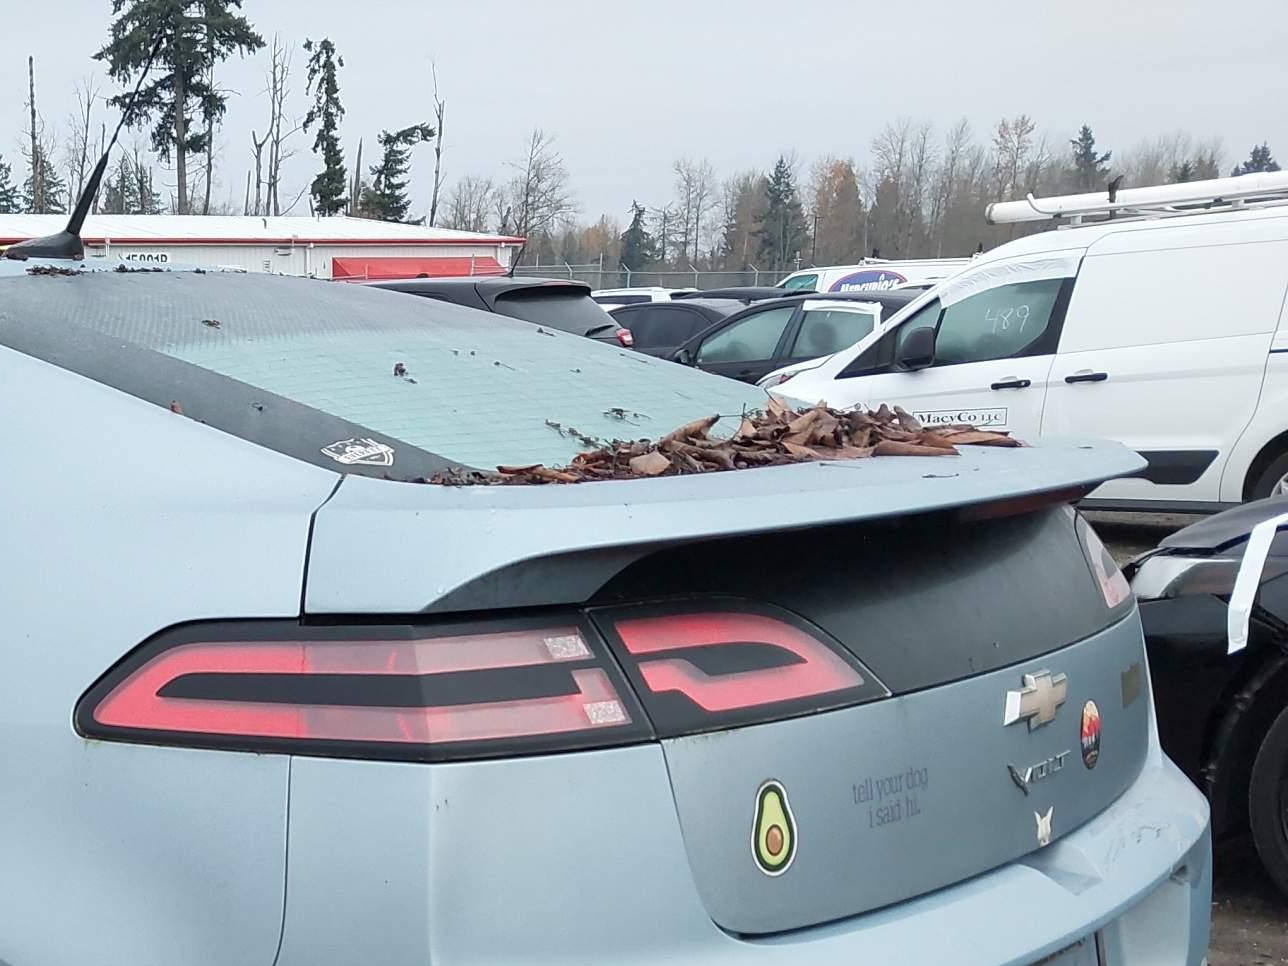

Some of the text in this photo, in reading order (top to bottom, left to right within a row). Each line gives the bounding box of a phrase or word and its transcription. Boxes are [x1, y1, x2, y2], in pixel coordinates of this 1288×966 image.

[984, 304, 1030, 334] 489
[918, 411, 977, 424] MacyCo
[853, 767, 929, 804] tell your dog
[1007, 749, 1071, 797] VOLT
[876, 800, 902, 826] said
